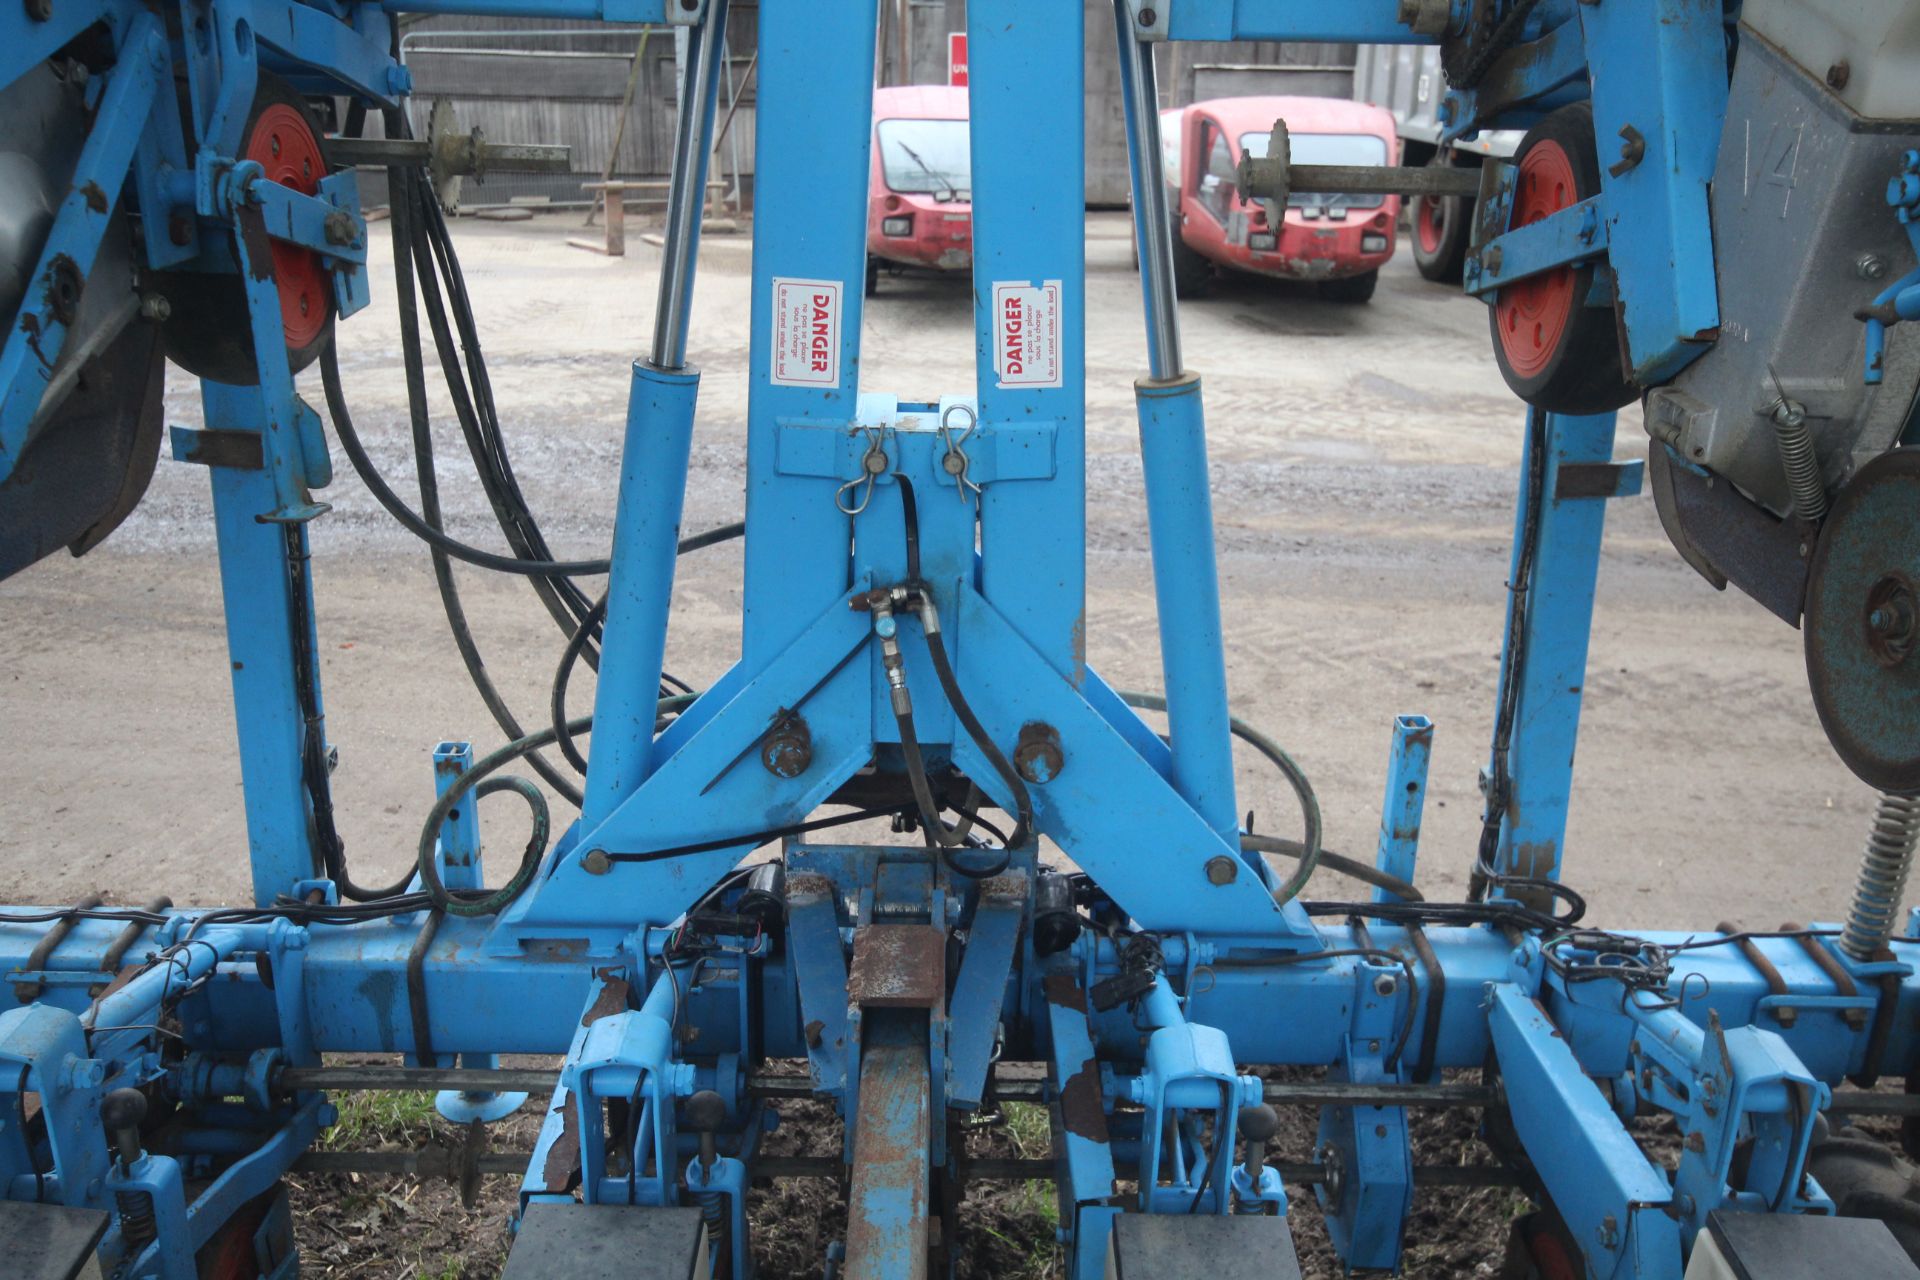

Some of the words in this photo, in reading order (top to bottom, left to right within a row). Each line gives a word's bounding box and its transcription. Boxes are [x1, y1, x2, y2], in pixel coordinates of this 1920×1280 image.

[802, 304, 808, 313] ne
[1025, 305, 1034, 327] placer
[1033, 310, 1042, 334] charge
[802, 331, 807, 339] se
[812, 295, 830, 372] DANGER
[1006, 297, 1022, 374] DANGER
[1028, 329, 1033, 338] se
[1034, 335, 1041, 343] la
[791, 334, 800, 358] charge
[800, 342, 809, 364] placer
[1028, 355, 1033, 364] ne
[1048, 369, 1054, 377] do
